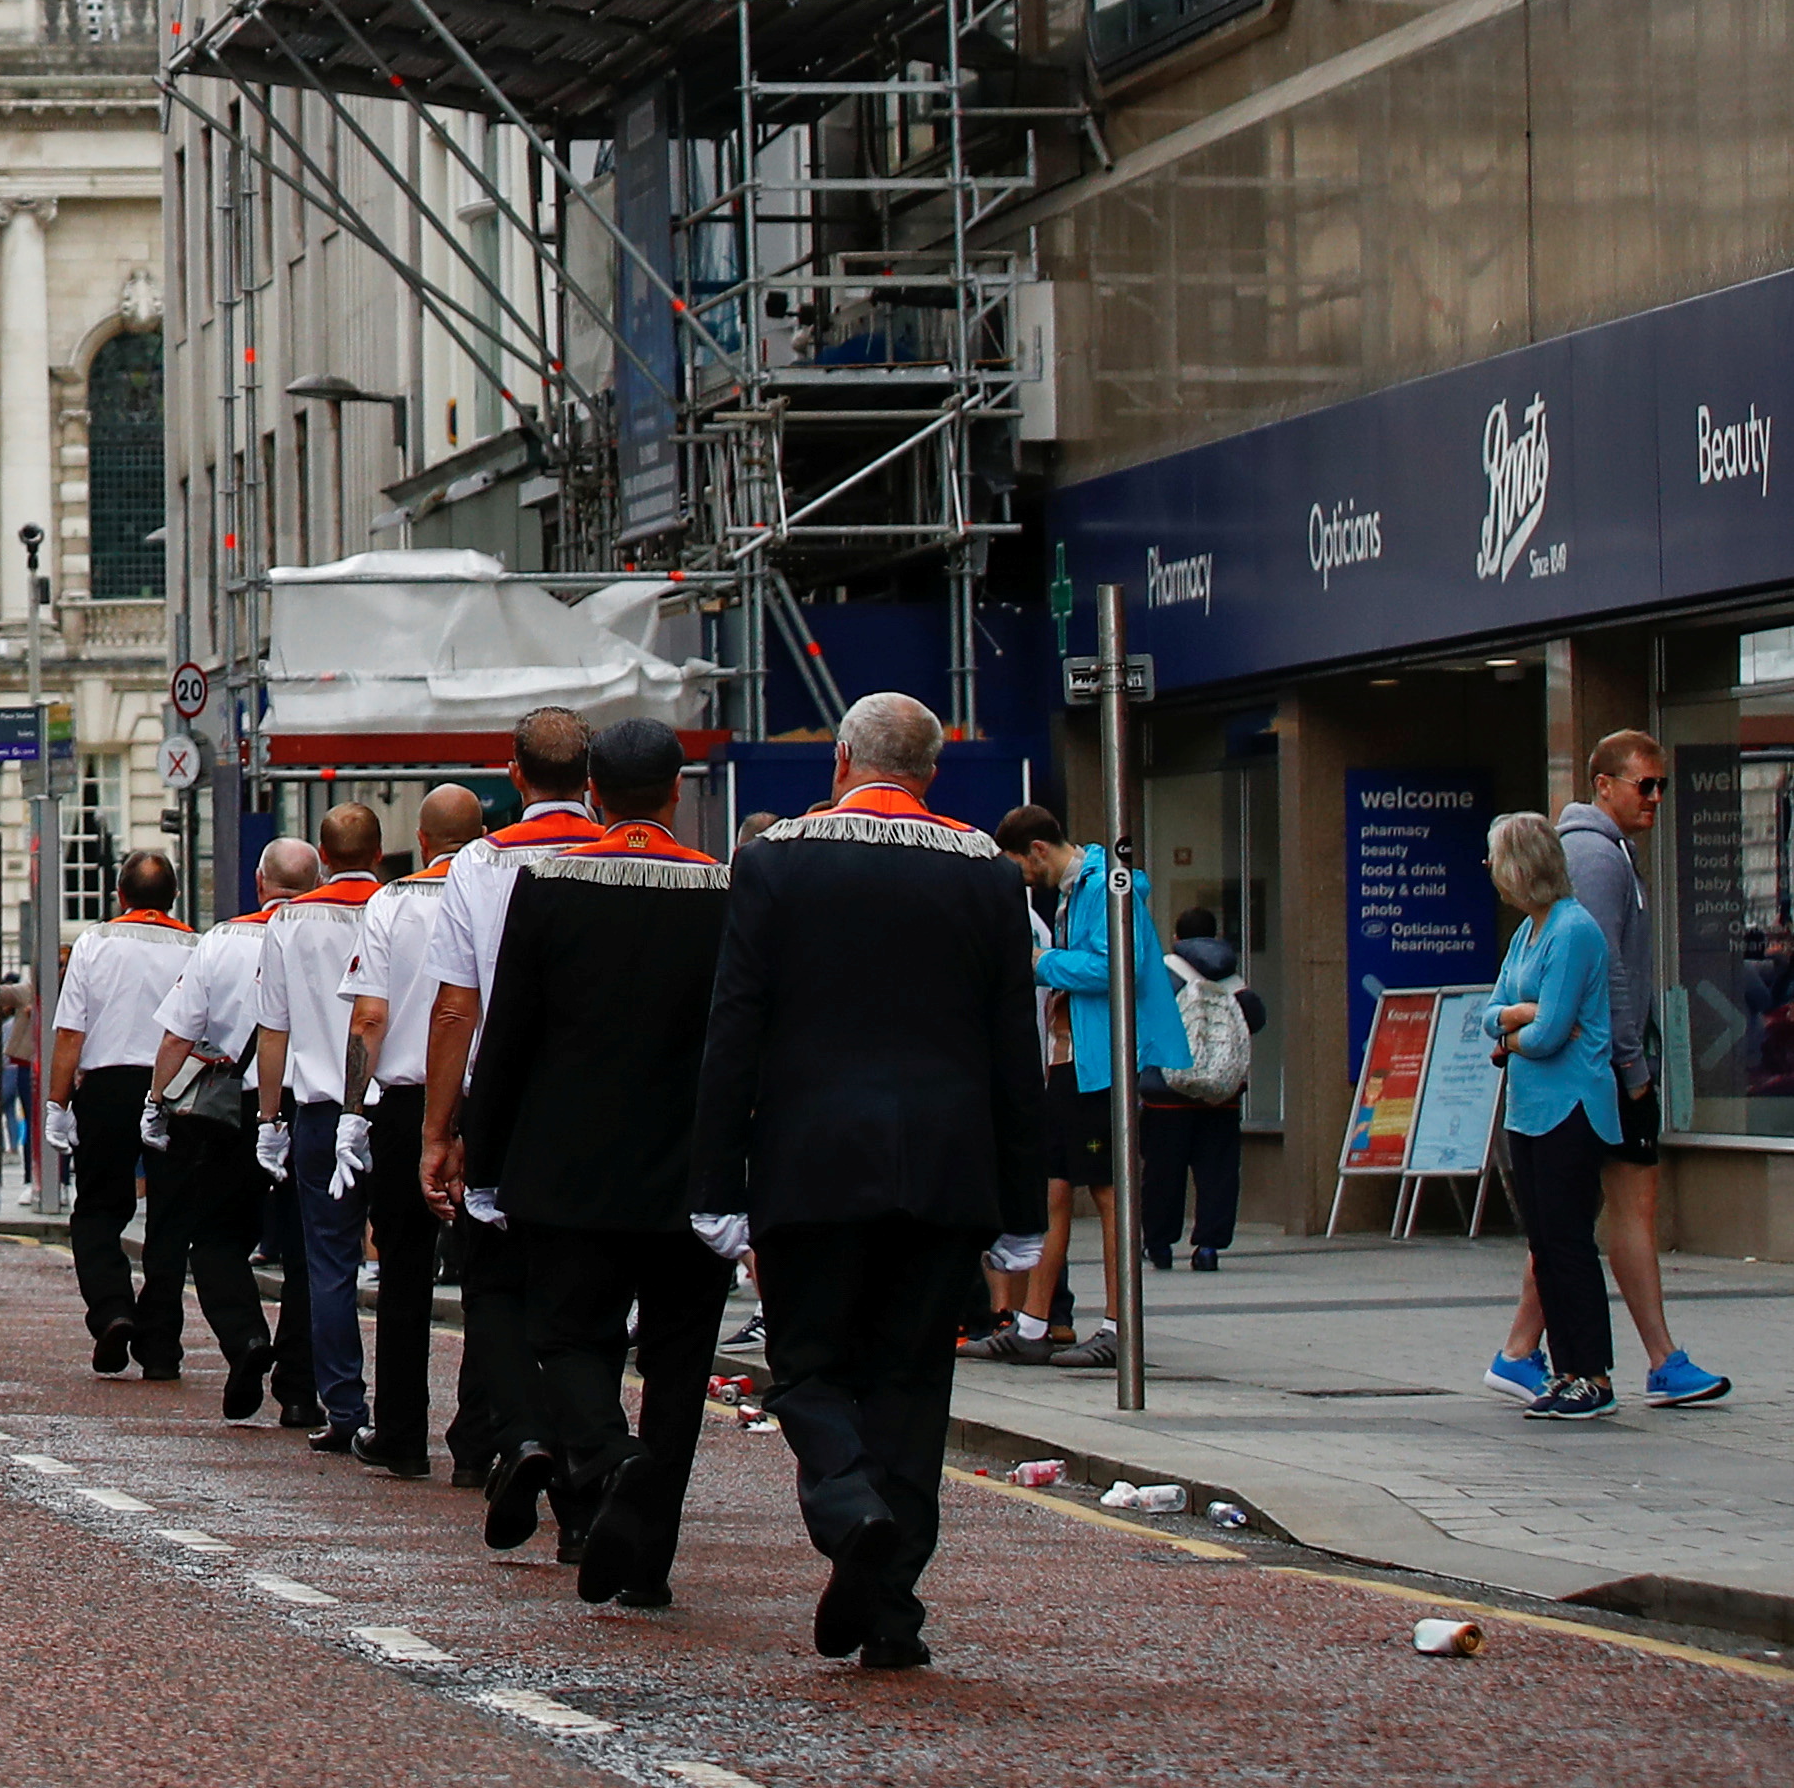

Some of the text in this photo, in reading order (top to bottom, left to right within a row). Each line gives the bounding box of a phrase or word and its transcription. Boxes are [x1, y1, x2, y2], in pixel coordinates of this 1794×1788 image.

[1697, 402, 1771, 497] Beauty
[1477, 391, 1550, 583] Boots
[1308, 498, 1382, 591] Opticians
[1147, 545, 1212, 616] Pharmacy
[178, 679, 203, 701] 20
[1361, 786, 1474, 809] welcome
[1361, 824, 1431, 839] pharmacy
[1692, 831, 1740, 847] beaut
[1361, 843, 1409, 859] beauty
[1361, 863, 1446, 876] food & drink
[1361, 883, 1446, 899] baby & child
[1361, 903, 1403, 918] photo
[1391, 922, 1458, 937] Opticians
[1461, 922, 1472, 935] &
[1391, 938, 1476, 954] hearingcare
